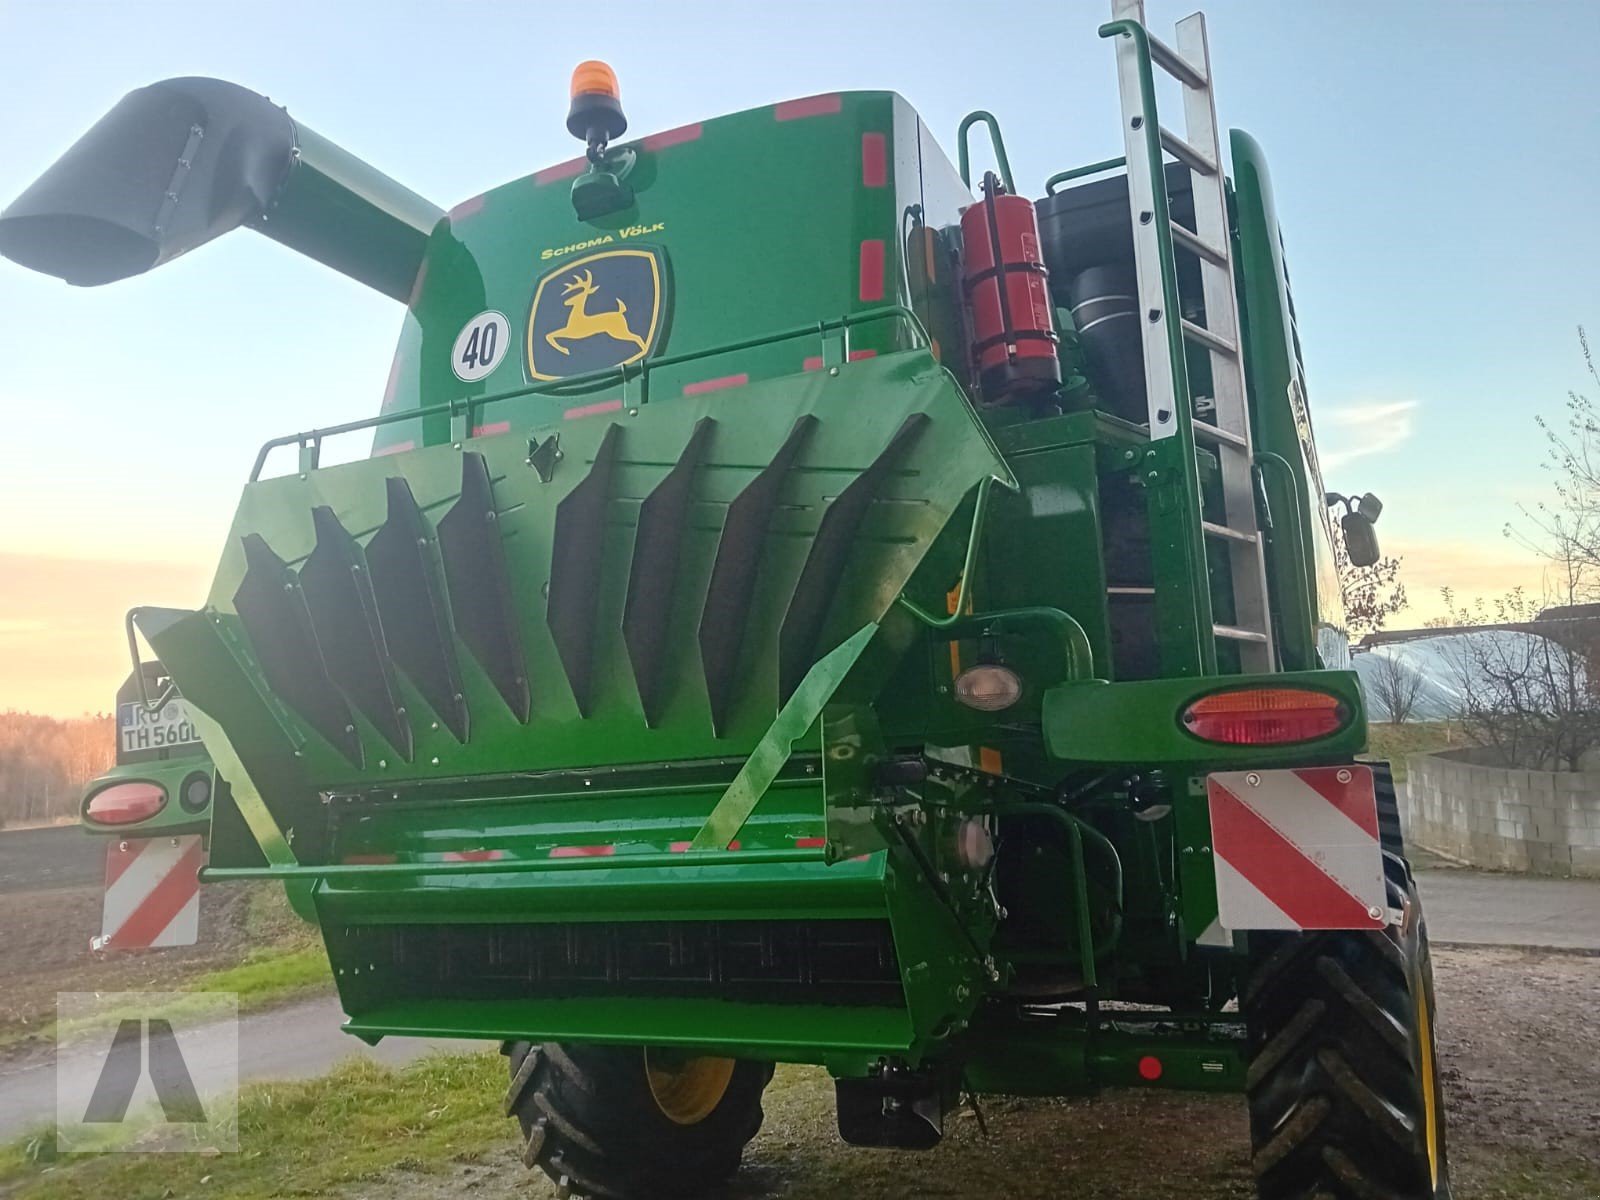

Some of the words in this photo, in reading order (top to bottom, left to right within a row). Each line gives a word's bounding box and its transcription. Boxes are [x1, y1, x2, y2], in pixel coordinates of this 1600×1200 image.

[541, 235, 614, 260] SCHOMA
[619, 222, 665, 239] VÖLK
[462, 322, 498, 370] 40
[124, 727, 150, 751] TH
